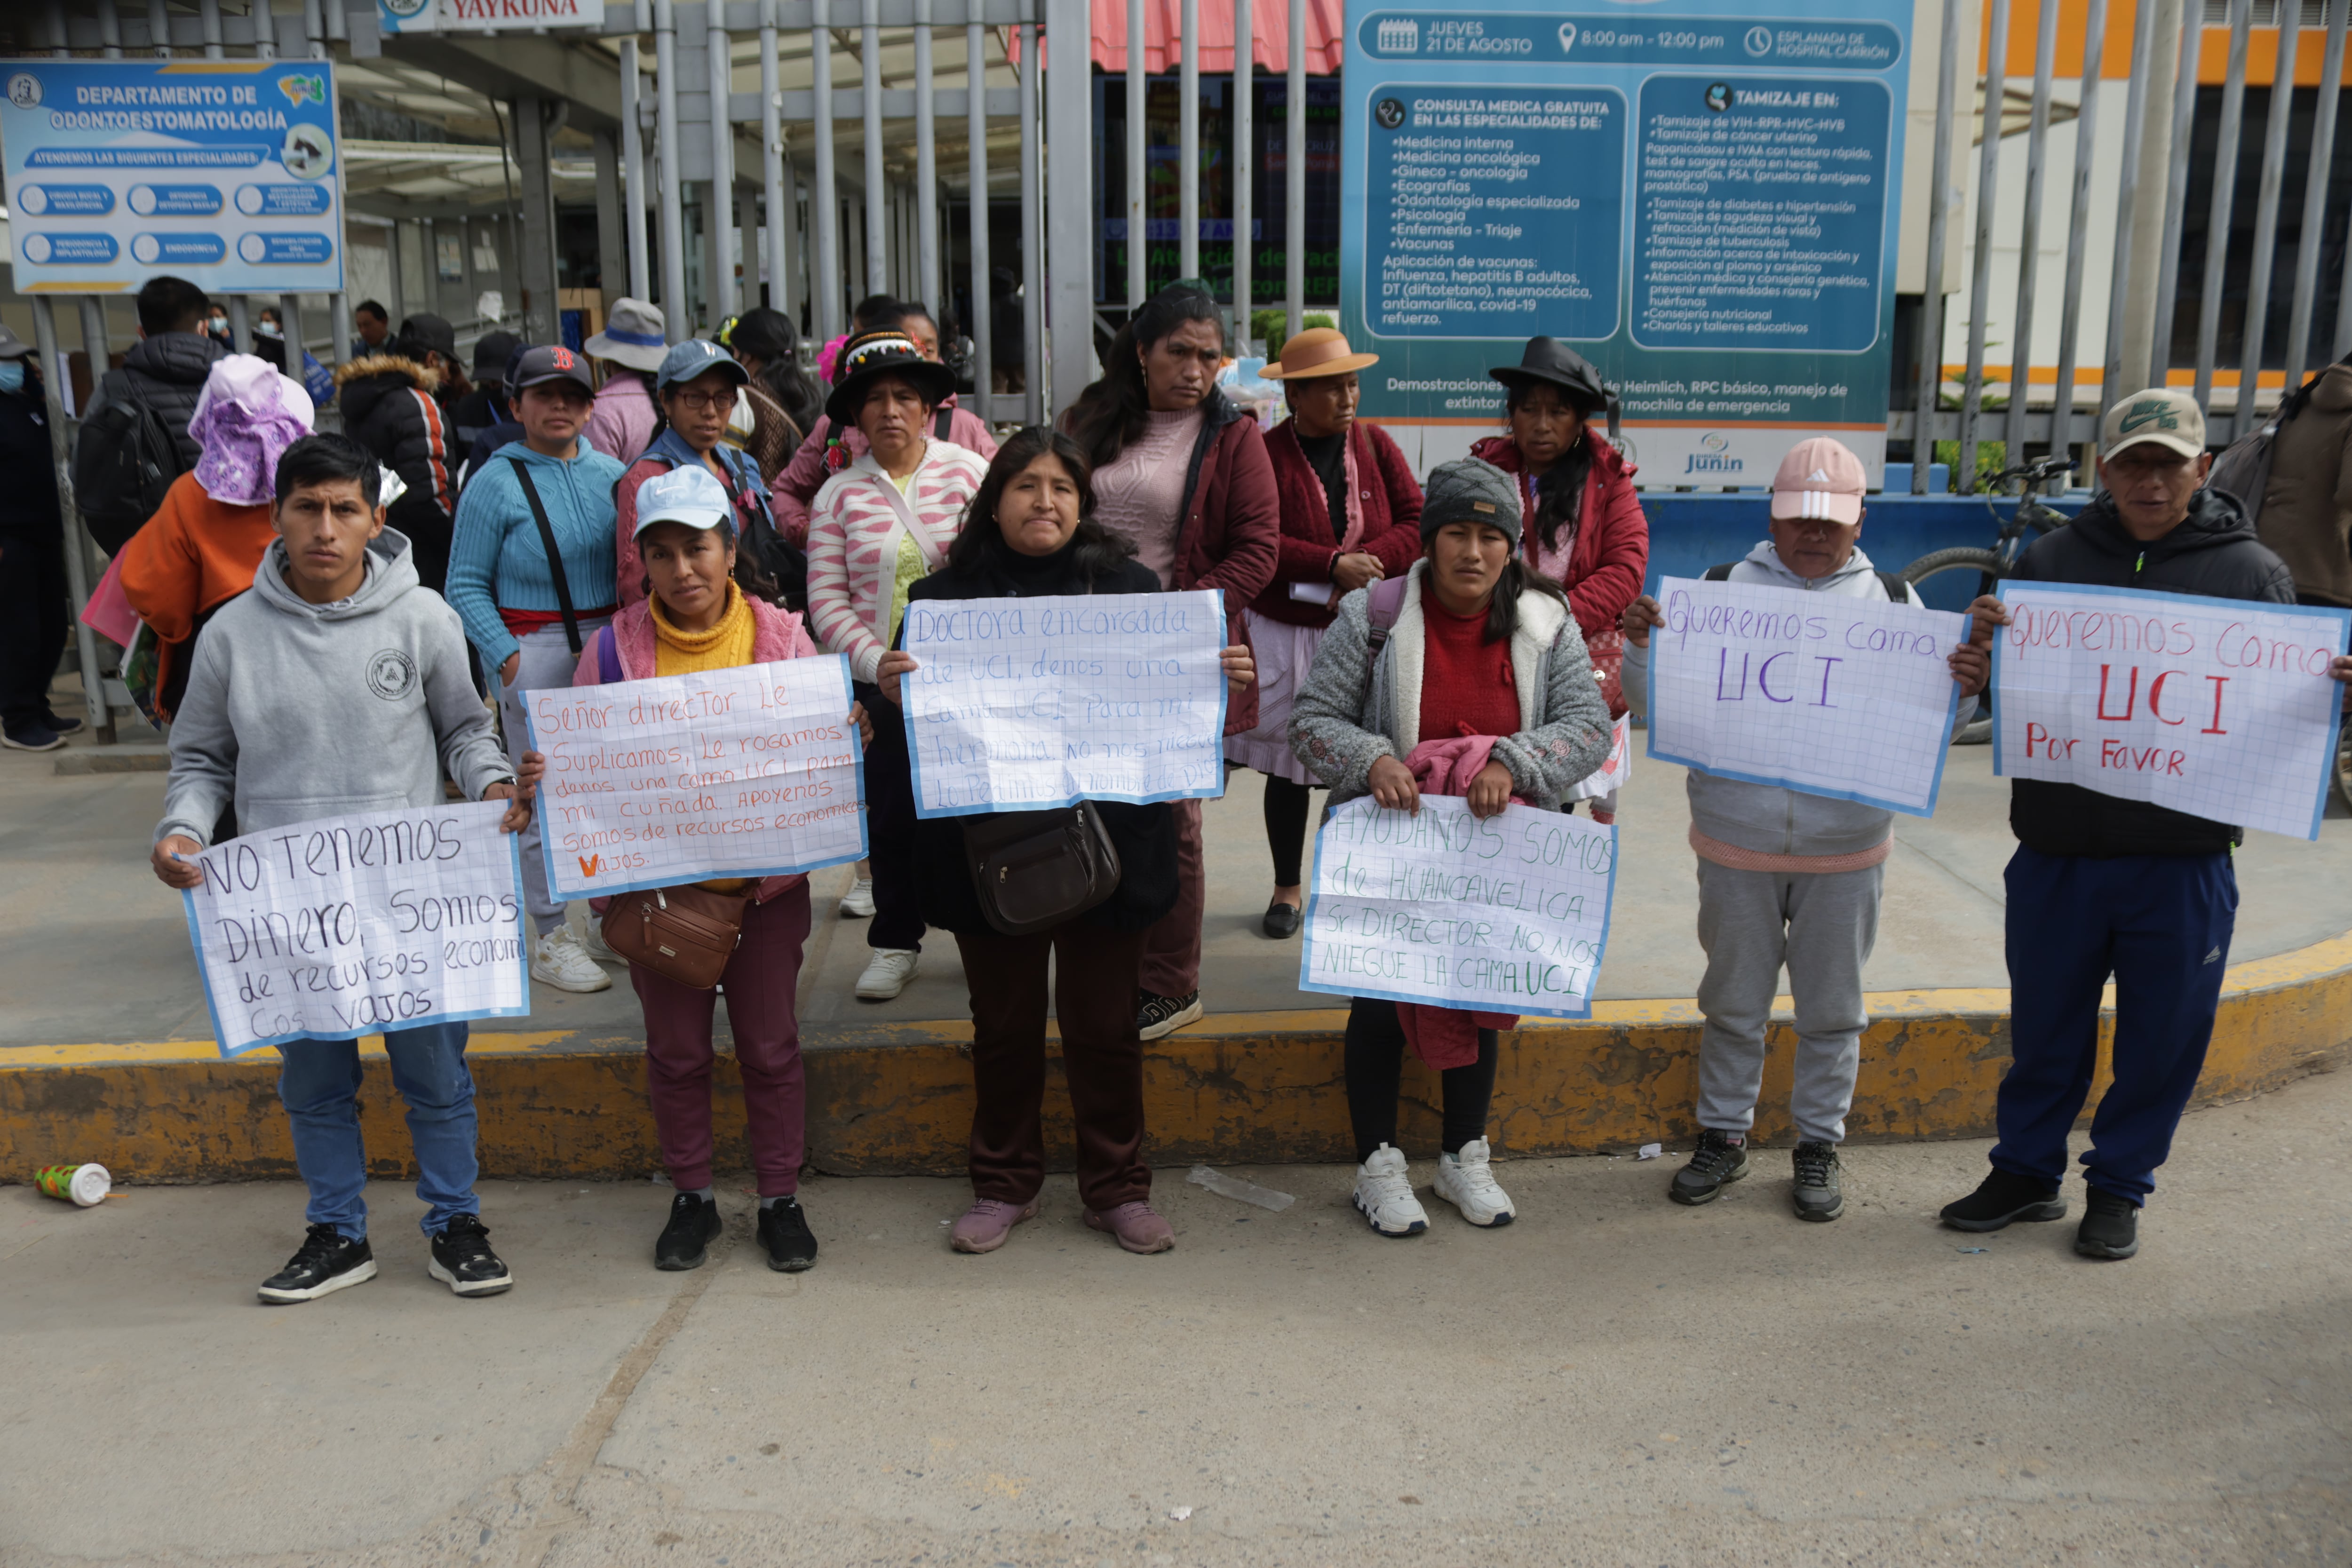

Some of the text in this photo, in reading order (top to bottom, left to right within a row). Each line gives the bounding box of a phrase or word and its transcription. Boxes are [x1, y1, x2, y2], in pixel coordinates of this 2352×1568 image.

[1427, 21, 1483, 35] JUEVES
[1581, 30, 1724, 52] 8:00 am 12:00 pm
[1777, 31, 1846, 44] ESPLANADA
[1427, 38, 1532, 55] 21 DE AGOSTO
[1776, 44, 1889, 60] HOSPITAL CARRIÓN
[77, 87, 257, 104] DEPARTAMENTO DE
[1737, 91, 1811, 107] TAMIZAJE
[1414, 100, 1609, 114] CONSULTA MEDICA GRATUITA
[50, 108, 287, 130] ODONTOESTOMATOLOGÍA
[1414, 114, 1602, 129] EN LAS ESPECIALIDADES DE:
[1657, 116, 1710, 129] Tamizaje
[1399, 136, 1514, 150] Medicina interna
[1657, 129, 1818, 143] Tamizaje cáncer uterino
[34, 151, 94, 164] ATENDEMOS
[95, 152, 114, 164] LAS
[117, 152, 175, 165] SIGUIENTES
[1646, 143, 1725, 158] Papanicolaou
[1790, 145, 1830, 158] lectura
[1399, 151, 1540, 167] Medicina oncológica
[1689, 158, 1766, 171] sangre oculta
[1398, 165, 1528, 183] Gineco oncología
[1754, 170, 1801, 186] (prueba
[1398, 179, 1470, 194] Ecografías
[1397, 194, 1580, 209] Odontología especializada
[1654, 198, 1856, 215] Tamizaje diabetes hipertensión
[1397, 209, 1465, 223] Psicología
[1654, 210, 1807, 225] Tamizaje agudeza visual
[1397, 223, 1522, 240] Enfermería Triaje
[1653, 223, 1821, 239] refracción (medición vista)
[1397, 238, 1454, 250] Vacunas
[1653, 236, 1789, 249] Tamizaje tuberculosis
[1383, 255, 1537, 269] Aplicación de vacunas:
[1652, 248, 1850, 262] Información acerca intoxicación
[1651, 261, 1821, 275] exposición plomo arsénico
[1383, 270, 1580, 285] Influenza, hepatitis B adultos,
[1651, 272, 1870, 289] Atención médica consejería genética,
[1383, 284, 1400, 295] DT
[1498, 285, 1592, 299] neumocócica,
[1650, 284, 1812, 298] prevenir enfermedades raras
[1480, 299, 1536, 311] covid-19
[1650, 296, 1707, 307] huérfanas
[1383, 312, 1441, 325] refuerzo.
[1650, 309, 1772, 322] Consejería nutricional
[1649, 320, 1808, 334] Charlas talleres educativos
[551, 347, 574, 370] B
[1387, 378, 1847, 398] Demostraciones Heimlich, RPC básico, manejo de
[1445, 396, 1790, 415] extintor mochila de emergencia
[2130, 401, 2172, 418] NIKE
[2010, 603, 2195, 660] Queremos
[922, 654, 952, 684] de
[1032, 649, 1103, 677] denos
[1127, 659, 1187, 679] una
[1717, 647, 1843, 708] UCI
[1014, 690, 1191, 720] UCI mi
[2097, 664, 2230, 735] UCI
[539, 683, 789, 733] Señor Le
[2026, 723, 2081, 760] Por
[1103, 743, 1147, 758] nos
[556, 754, 854, 798] denos una para
[1089, 771, 1151, 792] nombre
[558, 792, 723, 823] mi cuñada.
[643, 800, 866, 841] de recursos economicos
[1336, 804, 1616, 874] AYUDANOS SOMOS
[199, 819, 461, 895] NO Tenemos
[1332, 851, 1585, 922] de HUANCAVELICA
[215, 889, 518, 963] Dinero, Somos
[1362, 907, 1603, 967] DIRECTOR NOS
[239, 933, 526, 1003] de recursos economi
[1323, 943, 1446, 986] NIEGUE LA
